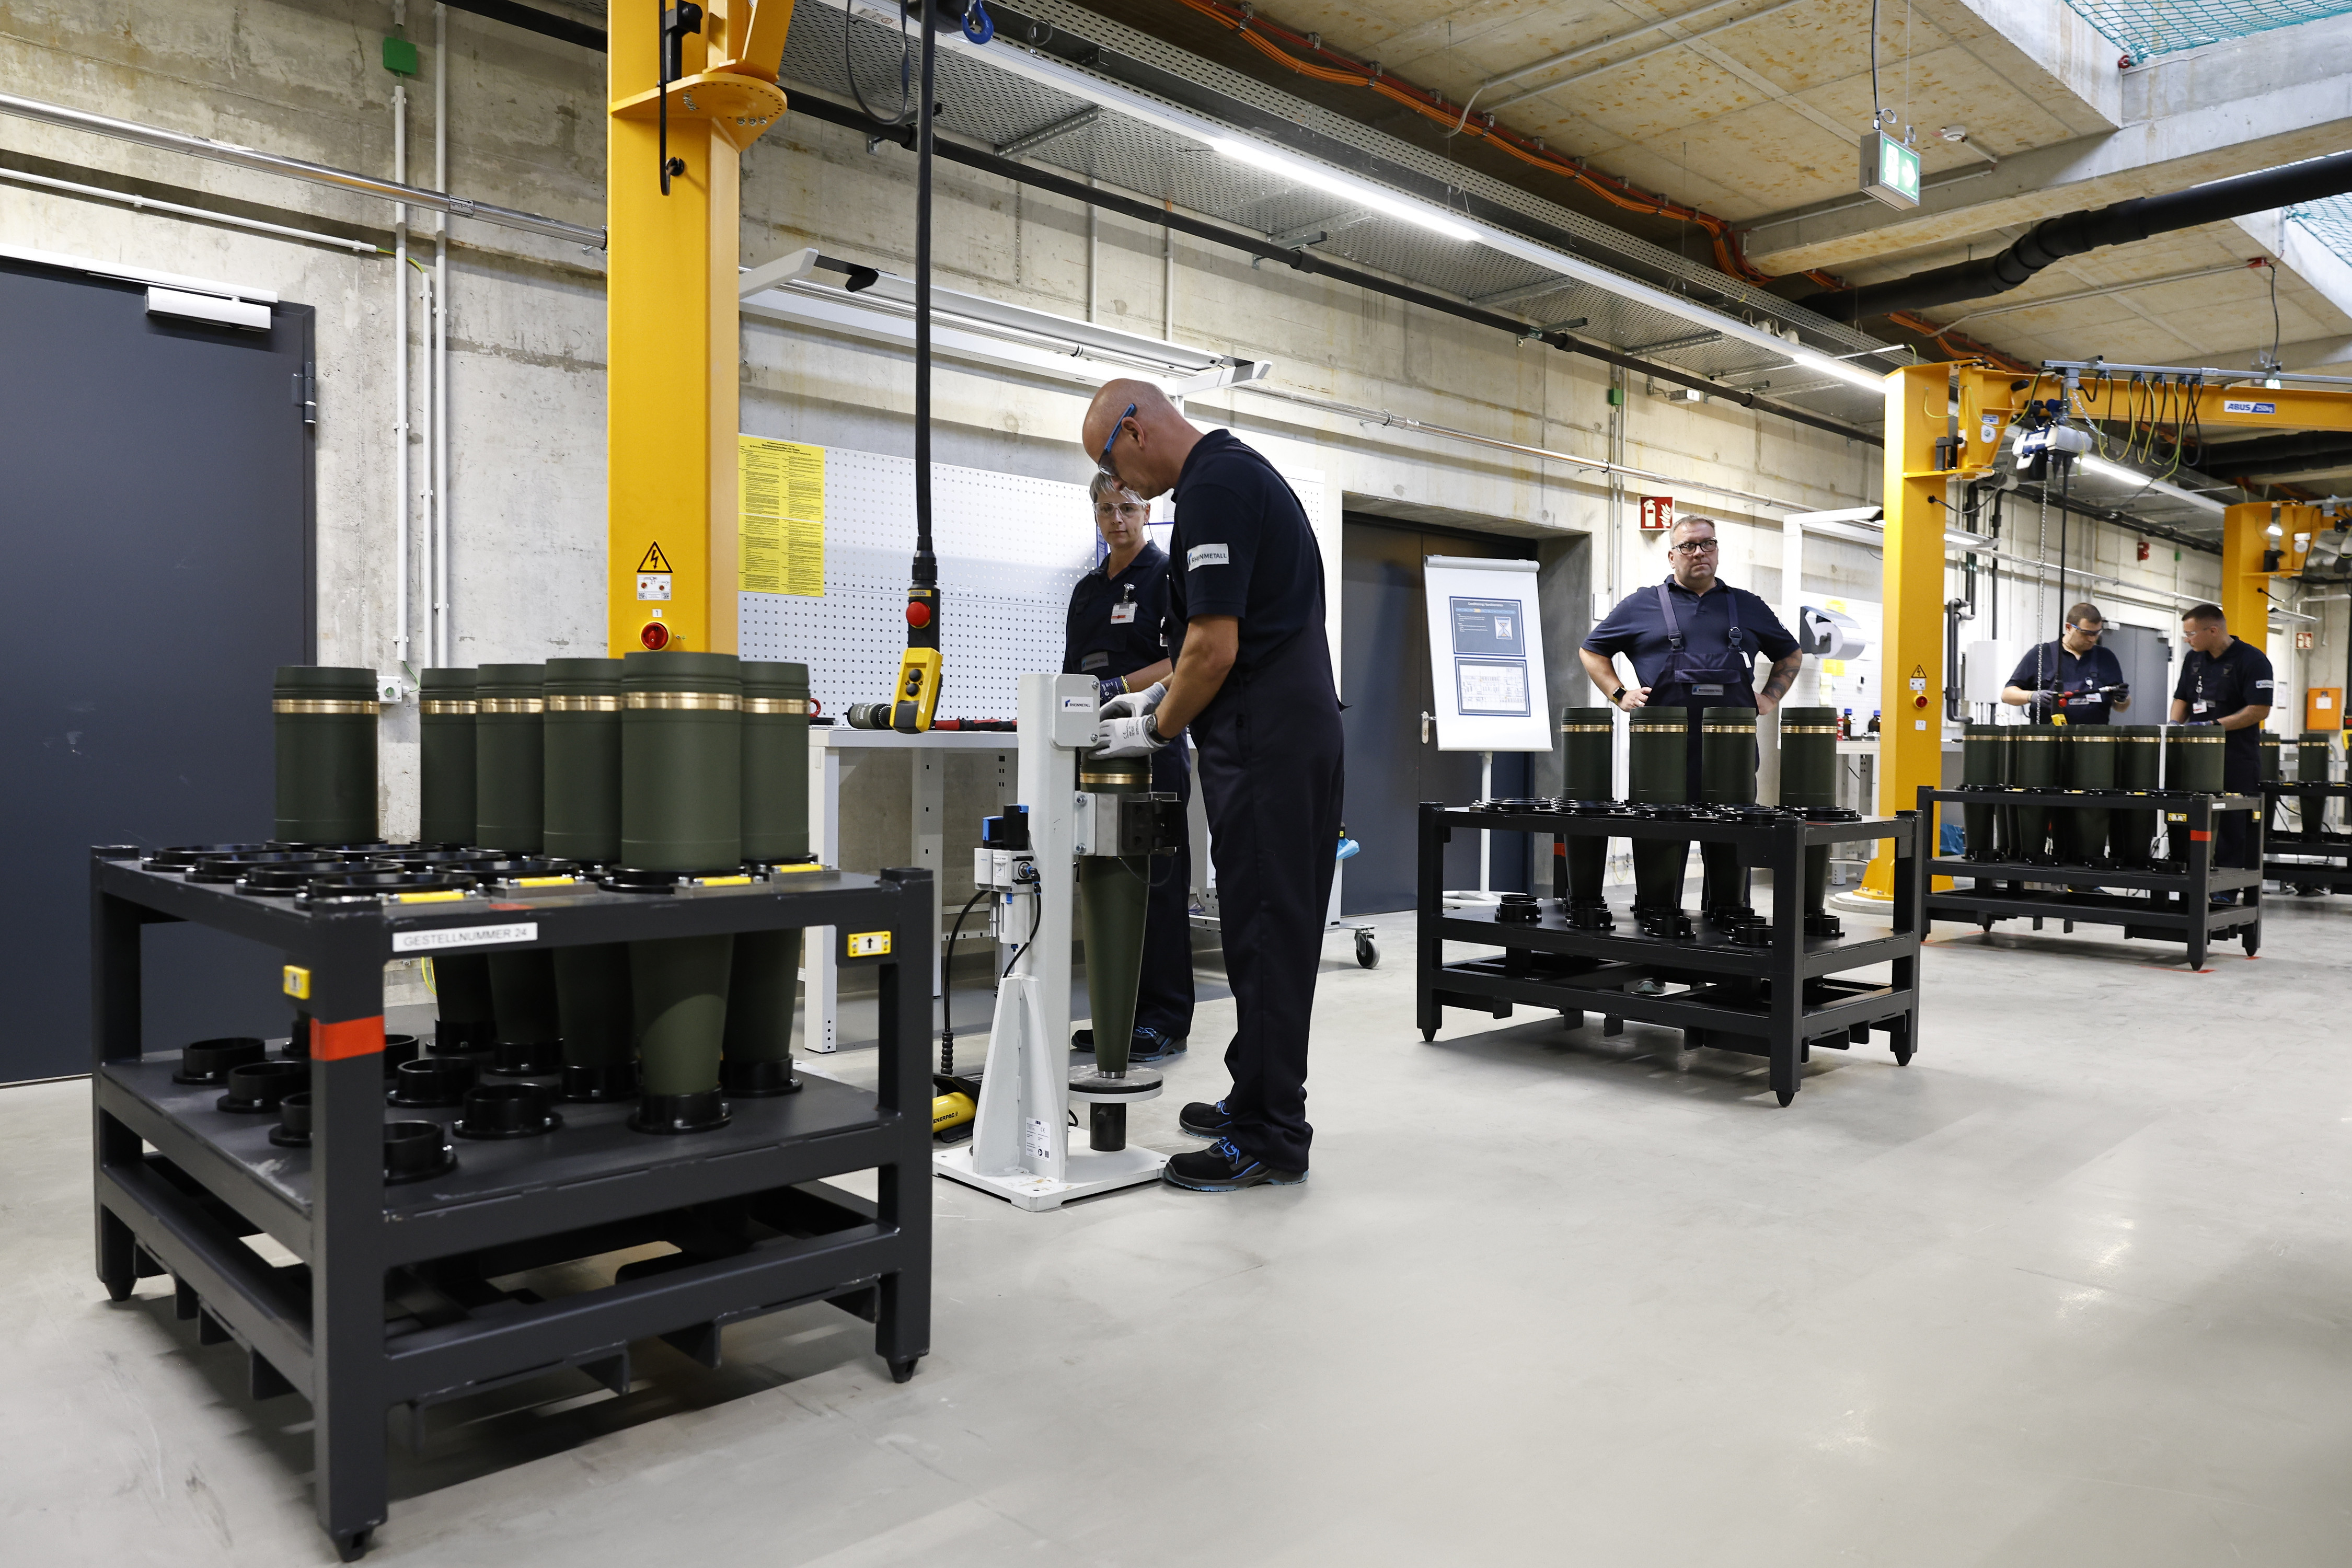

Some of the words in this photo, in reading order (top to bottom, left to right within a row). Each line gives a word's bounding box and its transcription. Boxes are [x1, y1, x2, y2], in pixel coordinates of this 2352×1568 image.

[403, 929, 511, 947] GESTELLNUMMER
[515, 928, 527, 937] 24
[933, 1113, 955, 1124] ENERPAC
